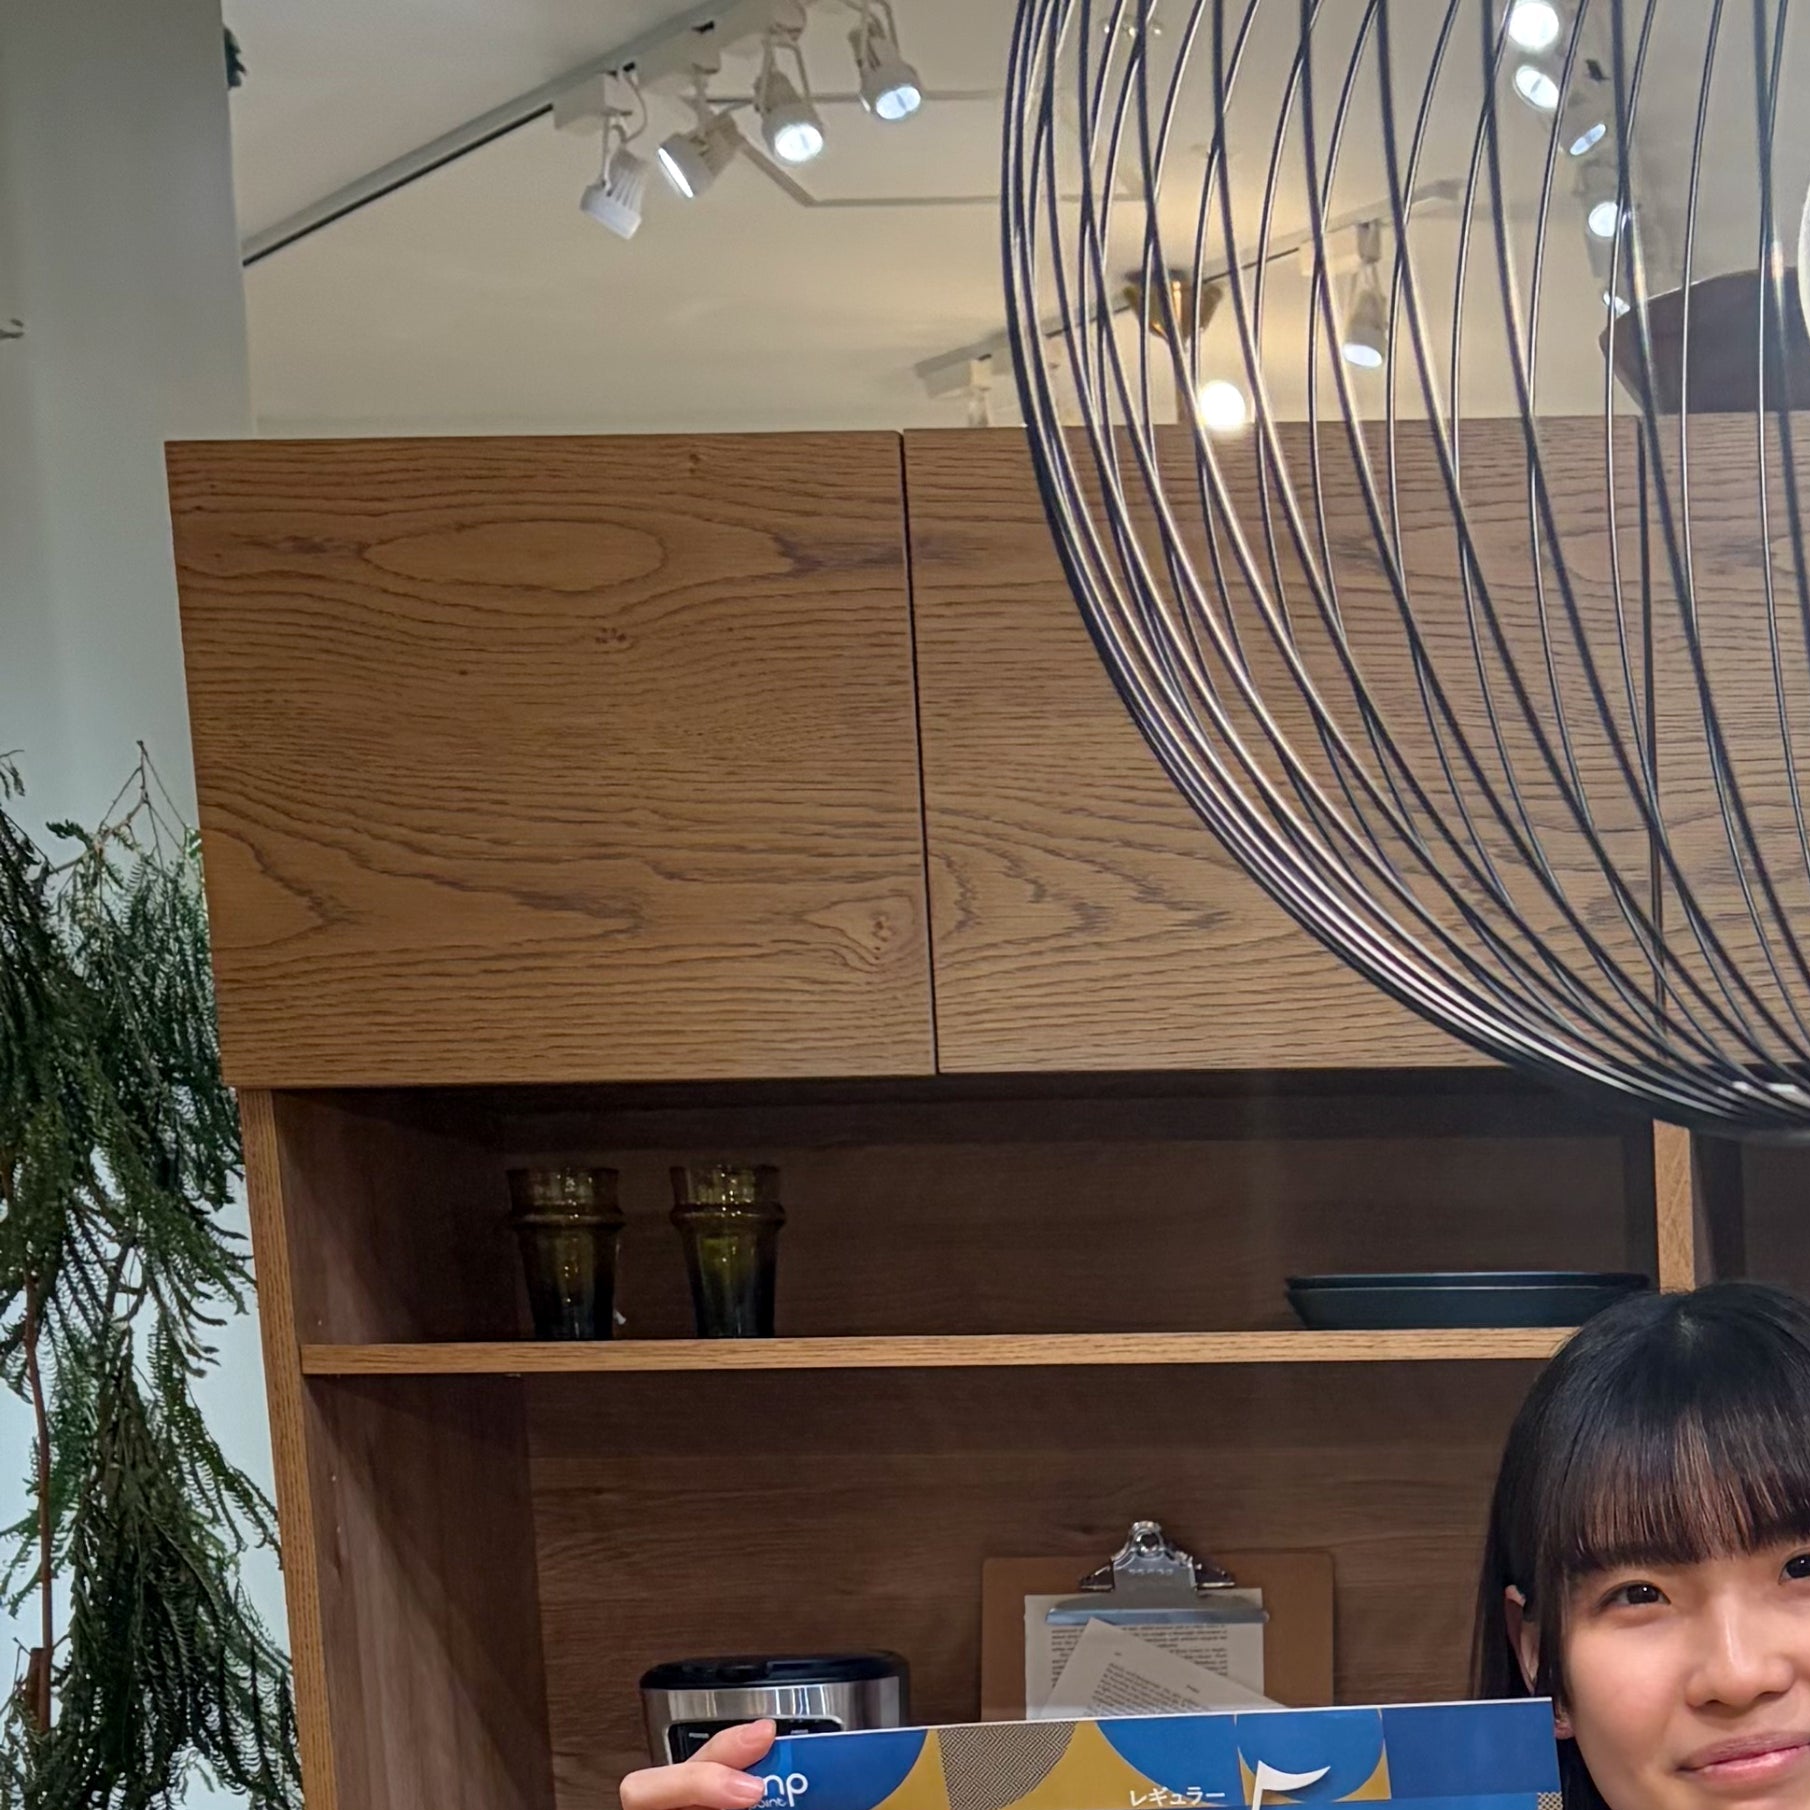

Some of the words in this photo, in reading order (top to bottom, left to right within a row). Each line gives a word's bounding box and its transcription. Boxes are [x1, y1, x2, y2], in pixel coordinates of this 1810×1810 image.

[1130, 1786, 1226, 1808] レギュラー
